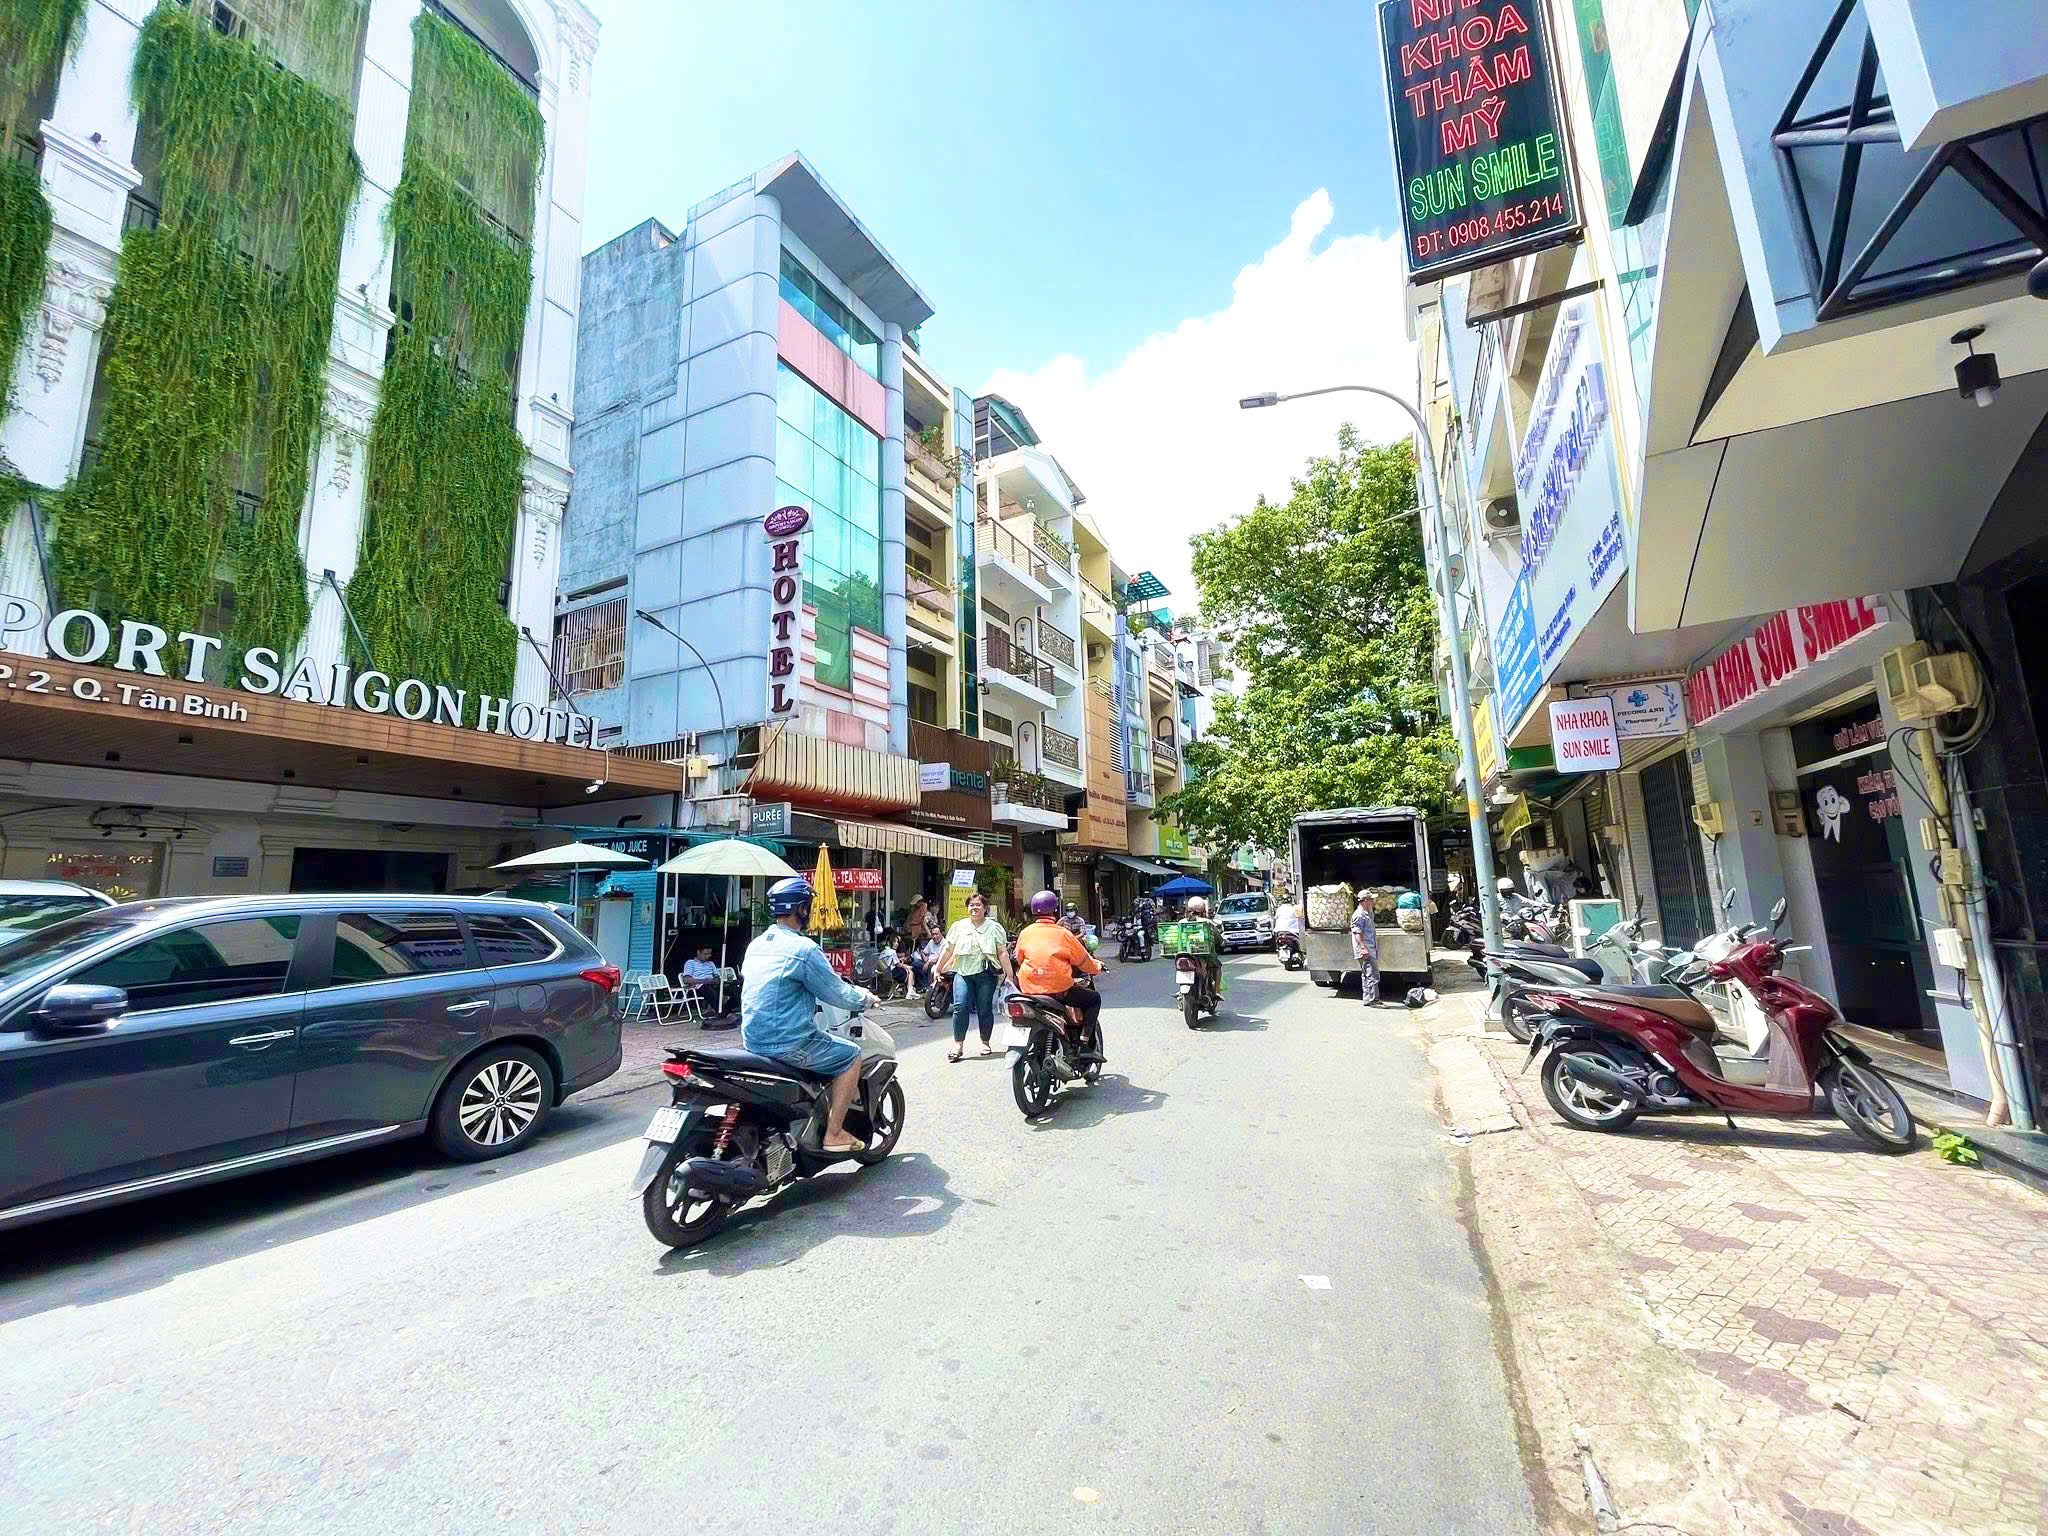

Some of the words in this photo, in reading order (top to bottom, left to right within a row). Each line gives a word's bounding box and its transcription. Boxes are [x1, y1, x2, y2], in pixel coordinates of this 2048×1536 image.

[1401, 4, 1528, 77] KHOA
[1441, 95, 1505, 155] MỸ
[1409, 164, 1467, 220] SUN
[1471, 133, 1559, 201] SMILE
[1417, 230, 1444, 256] ĐT:
[1448, 193, 1563, 247] 0908.455.214
[769, 540, 799, 713] HOTEL
[0, 594, 222, 683] PORT
[240, 647, 467, 728] SAIGON
[477, 694, 609, 751] HOTEL
[1712, 640, 1758, 711] KHOA
[1755, 610, 1798, 687] SUN
[72, 677, 110, 702] Q.
[117, 683, 176, 712] Tân
[183, 694, 249, 721] Bình
[1556, 714, 1578, 731] NHA
[1580, 710, 1609, 729] KHOA
[1562, 740, 1582, 758] SUN
[1583, 738, 1611, 757] SMILE
[840, 871, 853, 884] TEA
